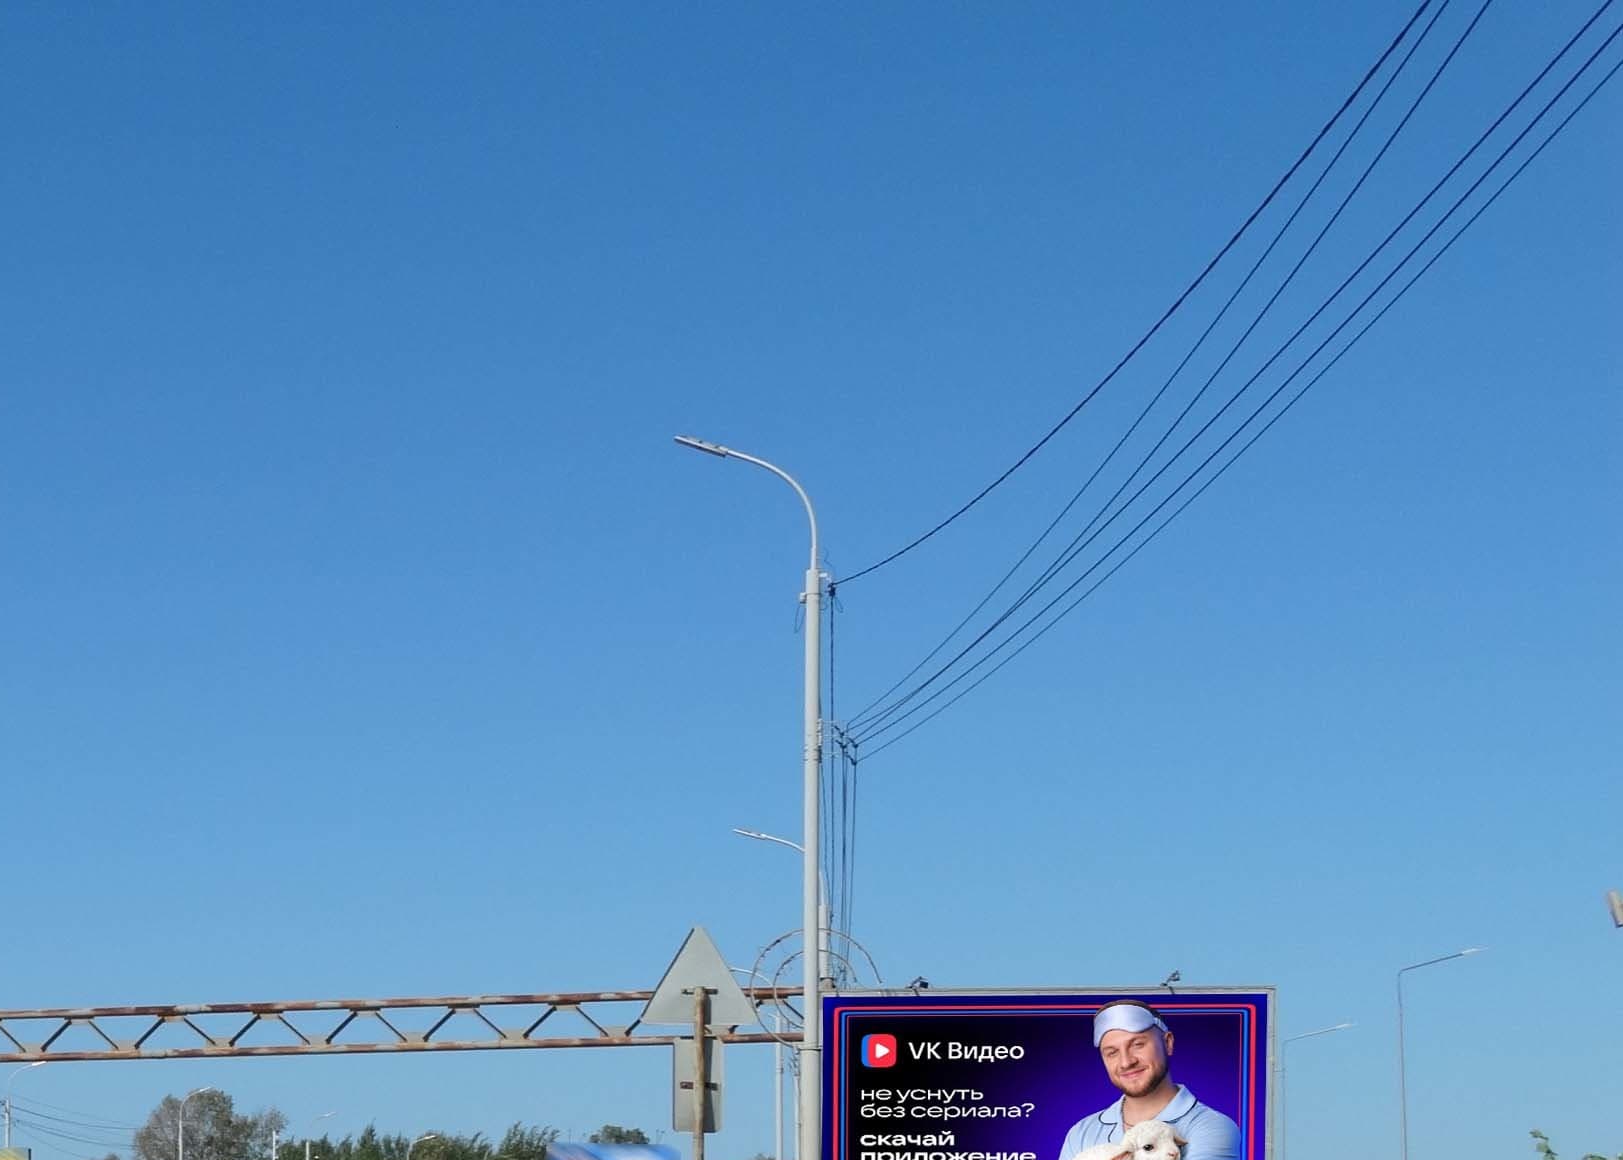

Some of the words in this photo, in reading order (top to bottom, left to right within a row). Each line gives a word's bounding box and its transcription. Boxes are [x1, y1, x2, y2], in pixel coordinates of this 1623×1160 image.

[908, 1042, 941, 1060] VK
[948, 1042, 1025, 1063] Видео
[860, 1088, 892, 1100] не
[895, 1088, 984, 1103] уснуть
[860, 1102, 905, 1118] без
[910, 1103, 1036, 1121] сериала?
[859, 1130, 955, 1146] скачай
